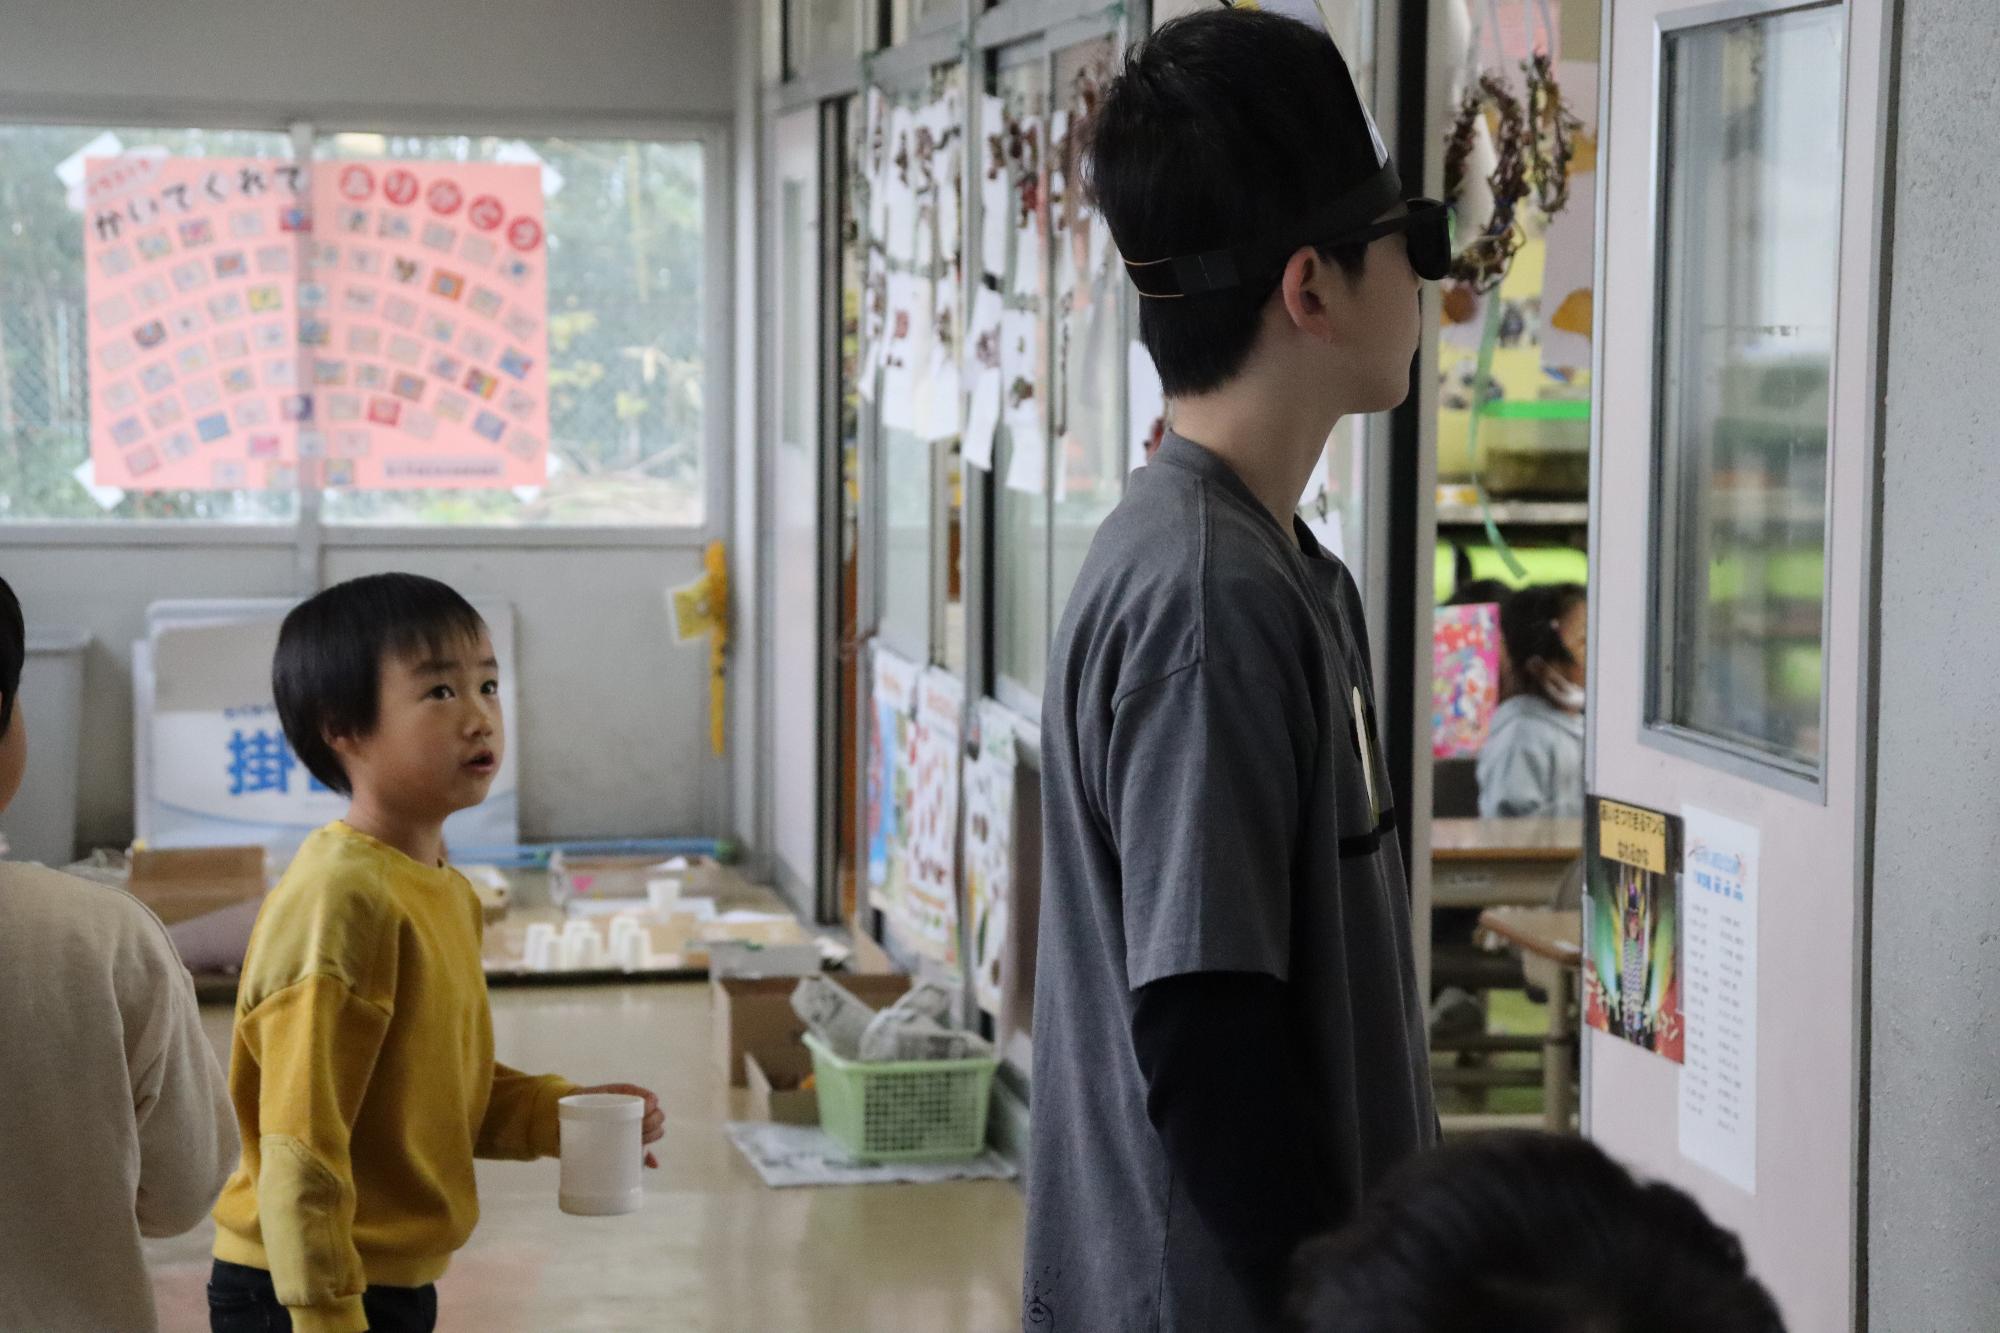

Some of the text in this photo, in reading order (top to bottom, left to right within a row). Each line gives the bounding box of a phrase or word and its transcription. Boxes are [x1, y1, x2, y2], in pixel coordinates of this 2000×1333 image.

[95, 162, 302, 241] かいてくれて
